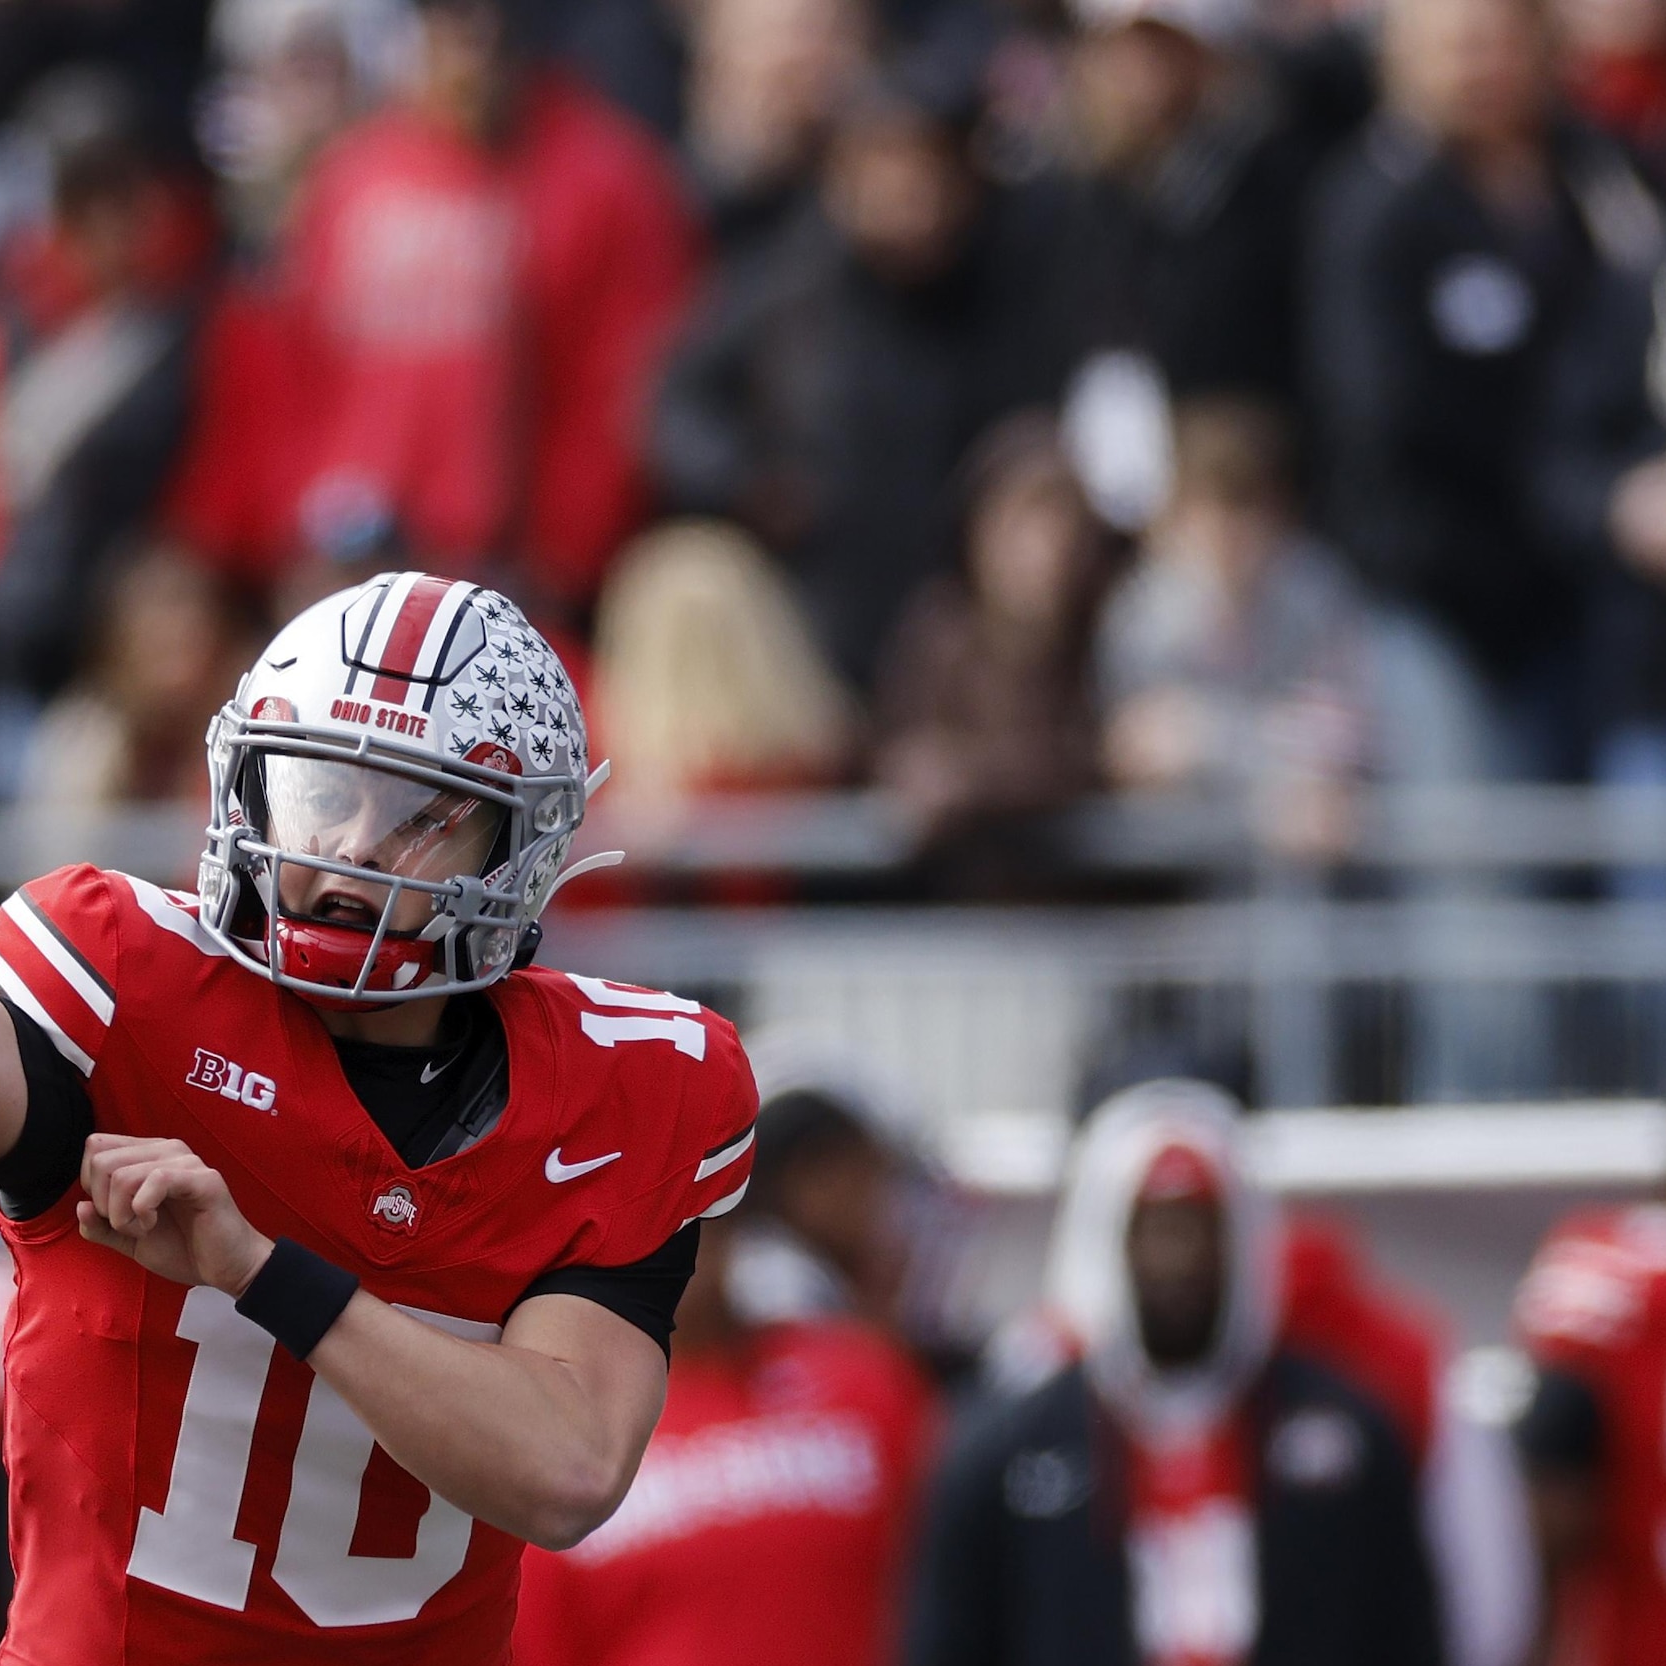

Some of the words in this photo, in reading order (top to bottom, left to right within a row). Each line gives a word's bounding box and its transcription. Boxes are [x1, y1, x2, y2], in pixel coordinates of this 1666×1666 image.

[331, 699, 371, 724] OHIO
[376, 709, 427, 738] STATE
[125, 1285, 502, 1628] 10
